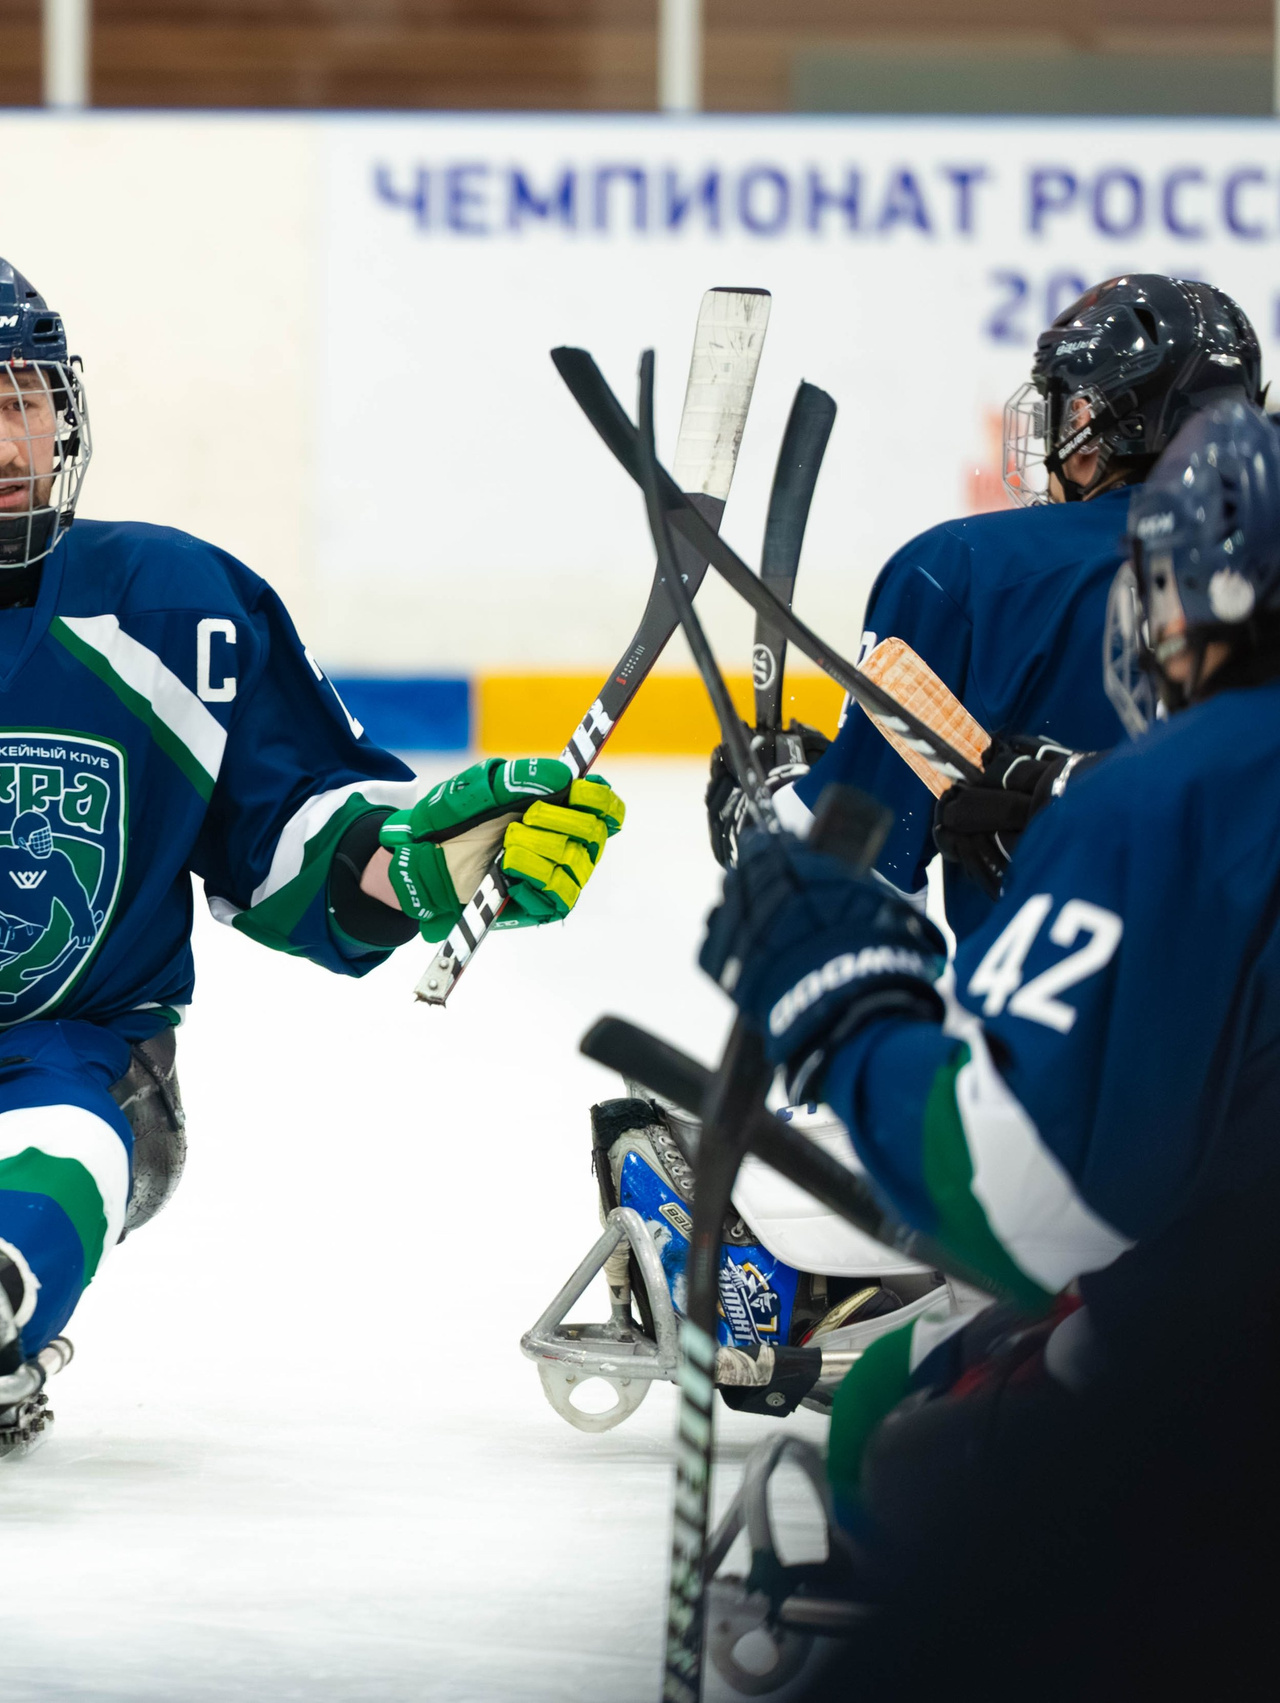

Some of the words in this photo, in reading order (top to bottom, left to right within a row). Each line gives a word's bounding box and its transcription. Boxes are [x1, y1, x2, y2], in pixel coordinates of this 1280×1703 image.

[373, 162, 988, 239] ЧЕМПИОНАТ
[1028, 164, 1280, 242] РОСС
[196, 618, 237, 702] C
[70, 751, 110, 769] КЛУБ
[399, 870, 421, 908] CCM
[967, 892, 1124, 1036] 42
[666, 1208, 694, 1232] BAU
